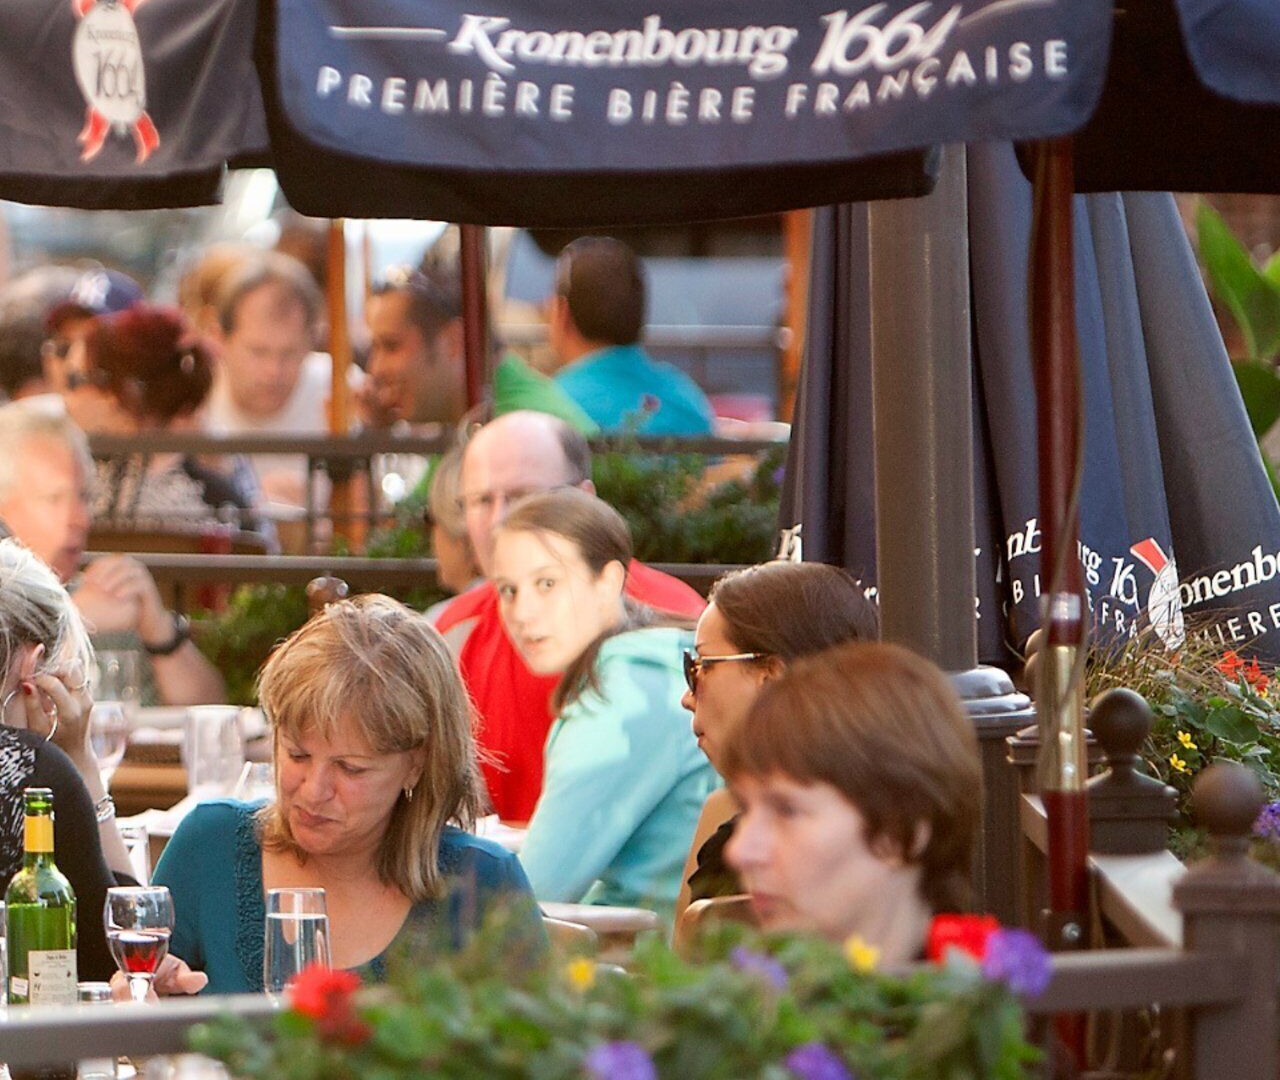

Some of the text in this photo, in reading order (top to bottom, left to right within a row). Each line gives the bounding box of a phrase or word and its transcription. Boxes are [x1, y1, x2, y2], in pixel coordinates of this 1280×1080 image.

[447, 0, 963, 80] Kronenbourg 1664
[314, 39, 1069, 125] PREMIÈRE BIÈRE FRANÇAISE
